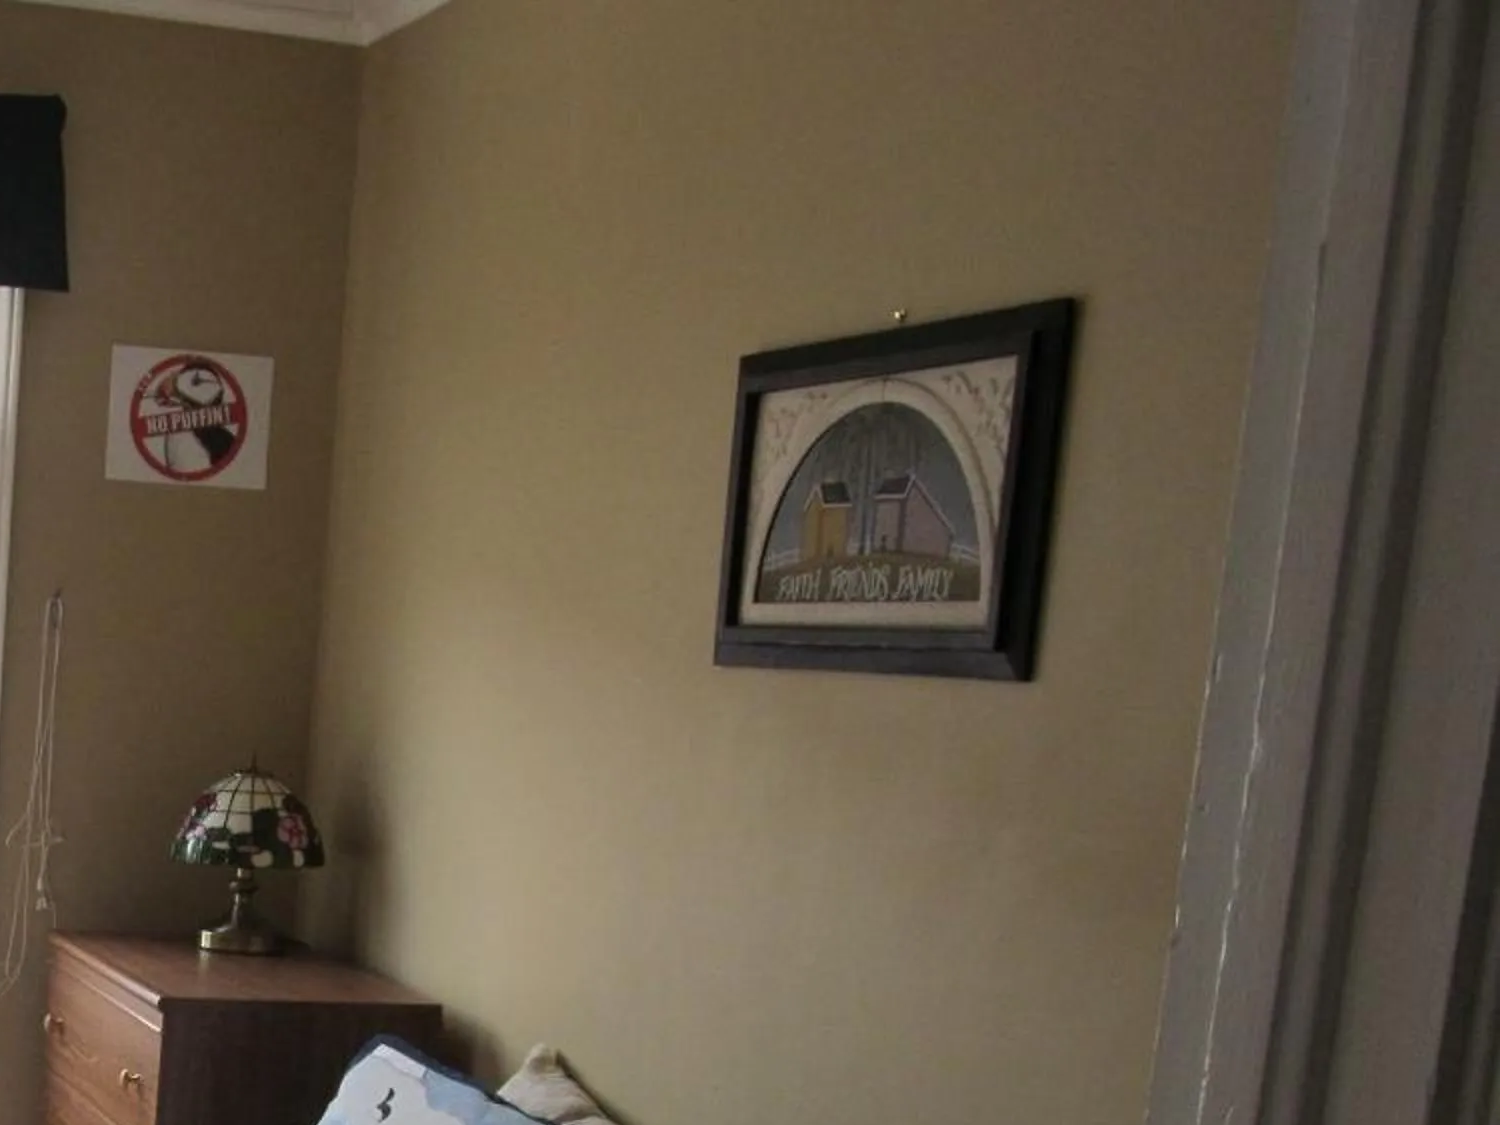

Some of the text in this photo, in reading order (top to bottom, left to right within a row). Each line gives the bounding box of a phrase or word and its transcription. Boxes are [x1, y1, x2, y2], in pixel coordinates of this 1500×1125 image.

[147, 415, 168, 434] NO
[776, 563, 953, 601] FAITH FRIENDS FAMILY
